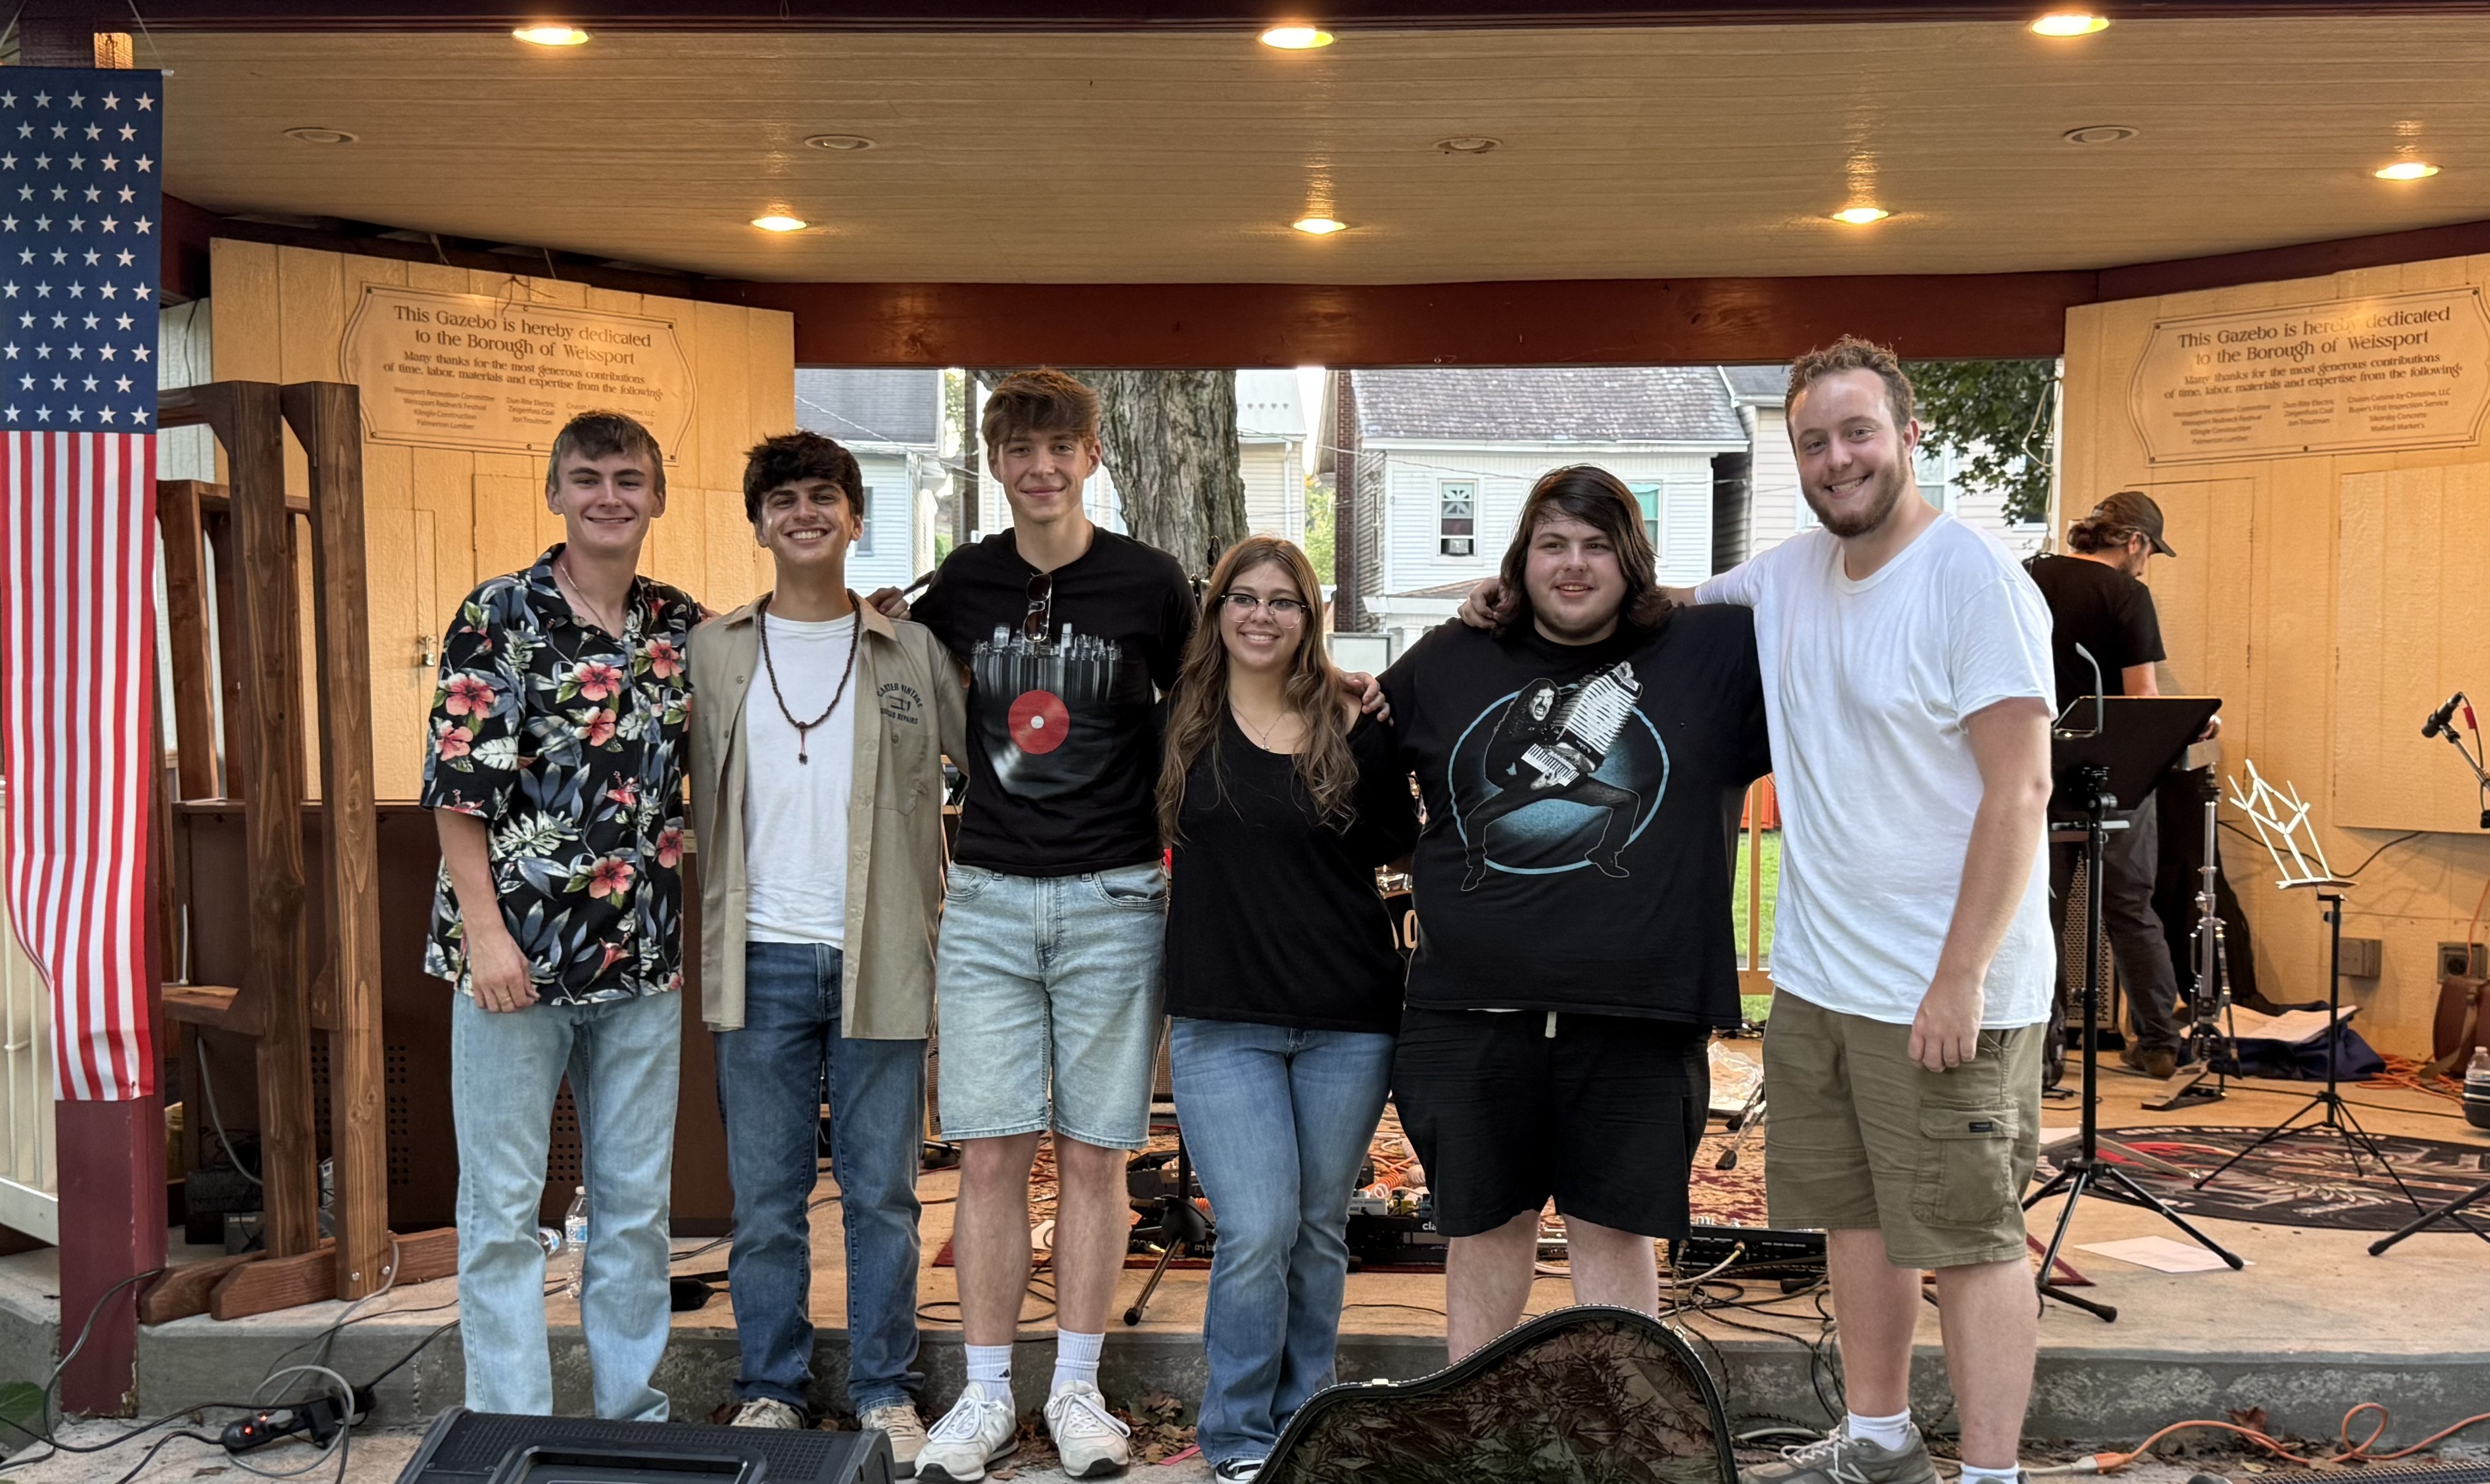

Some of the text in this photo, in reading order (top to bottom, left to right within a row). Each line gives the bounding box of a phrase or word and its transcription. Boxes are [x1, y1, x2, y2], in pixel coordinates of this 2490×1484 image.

[394, 305, 651, 347] This Gazebo is hereby dedicated
[2178, 306, 2450, 348] This Gazebo is hereby dedicated
[416, 328, 635, 366] to the Borough of Weissport
[2197, 330, 2429, 365] to the Borough of Weissport
[383, 362, 395, 372] of
[459, 371, 503, 382] materials
[507, 375, 526, 385] and
[529, 378, 574, 389] expertise
[577, 381, 599, 392] from
[602, 382, 617, 393] the
[404, 351, 645, 384] Many thanks for the most generous contributions
[2185, 353, 2441, 385] Many thanks for the most generous contributions
[2164, 388, 2175, 399] of
[2236, 381, 2281, 392] materials
[2284, 378, 2304, 388] and
[2307, 373, 2357, 388] expertise
[2360, 370, 2386, 382] from
[2390, 368, 2406, 379] the
[437, 411, 477, 420] Construction
[2388, 402, 2424, 410] Inspection
[901, 684, 923, 708] VINTAGE
[897, 713, 918, 725] REPAIRS
